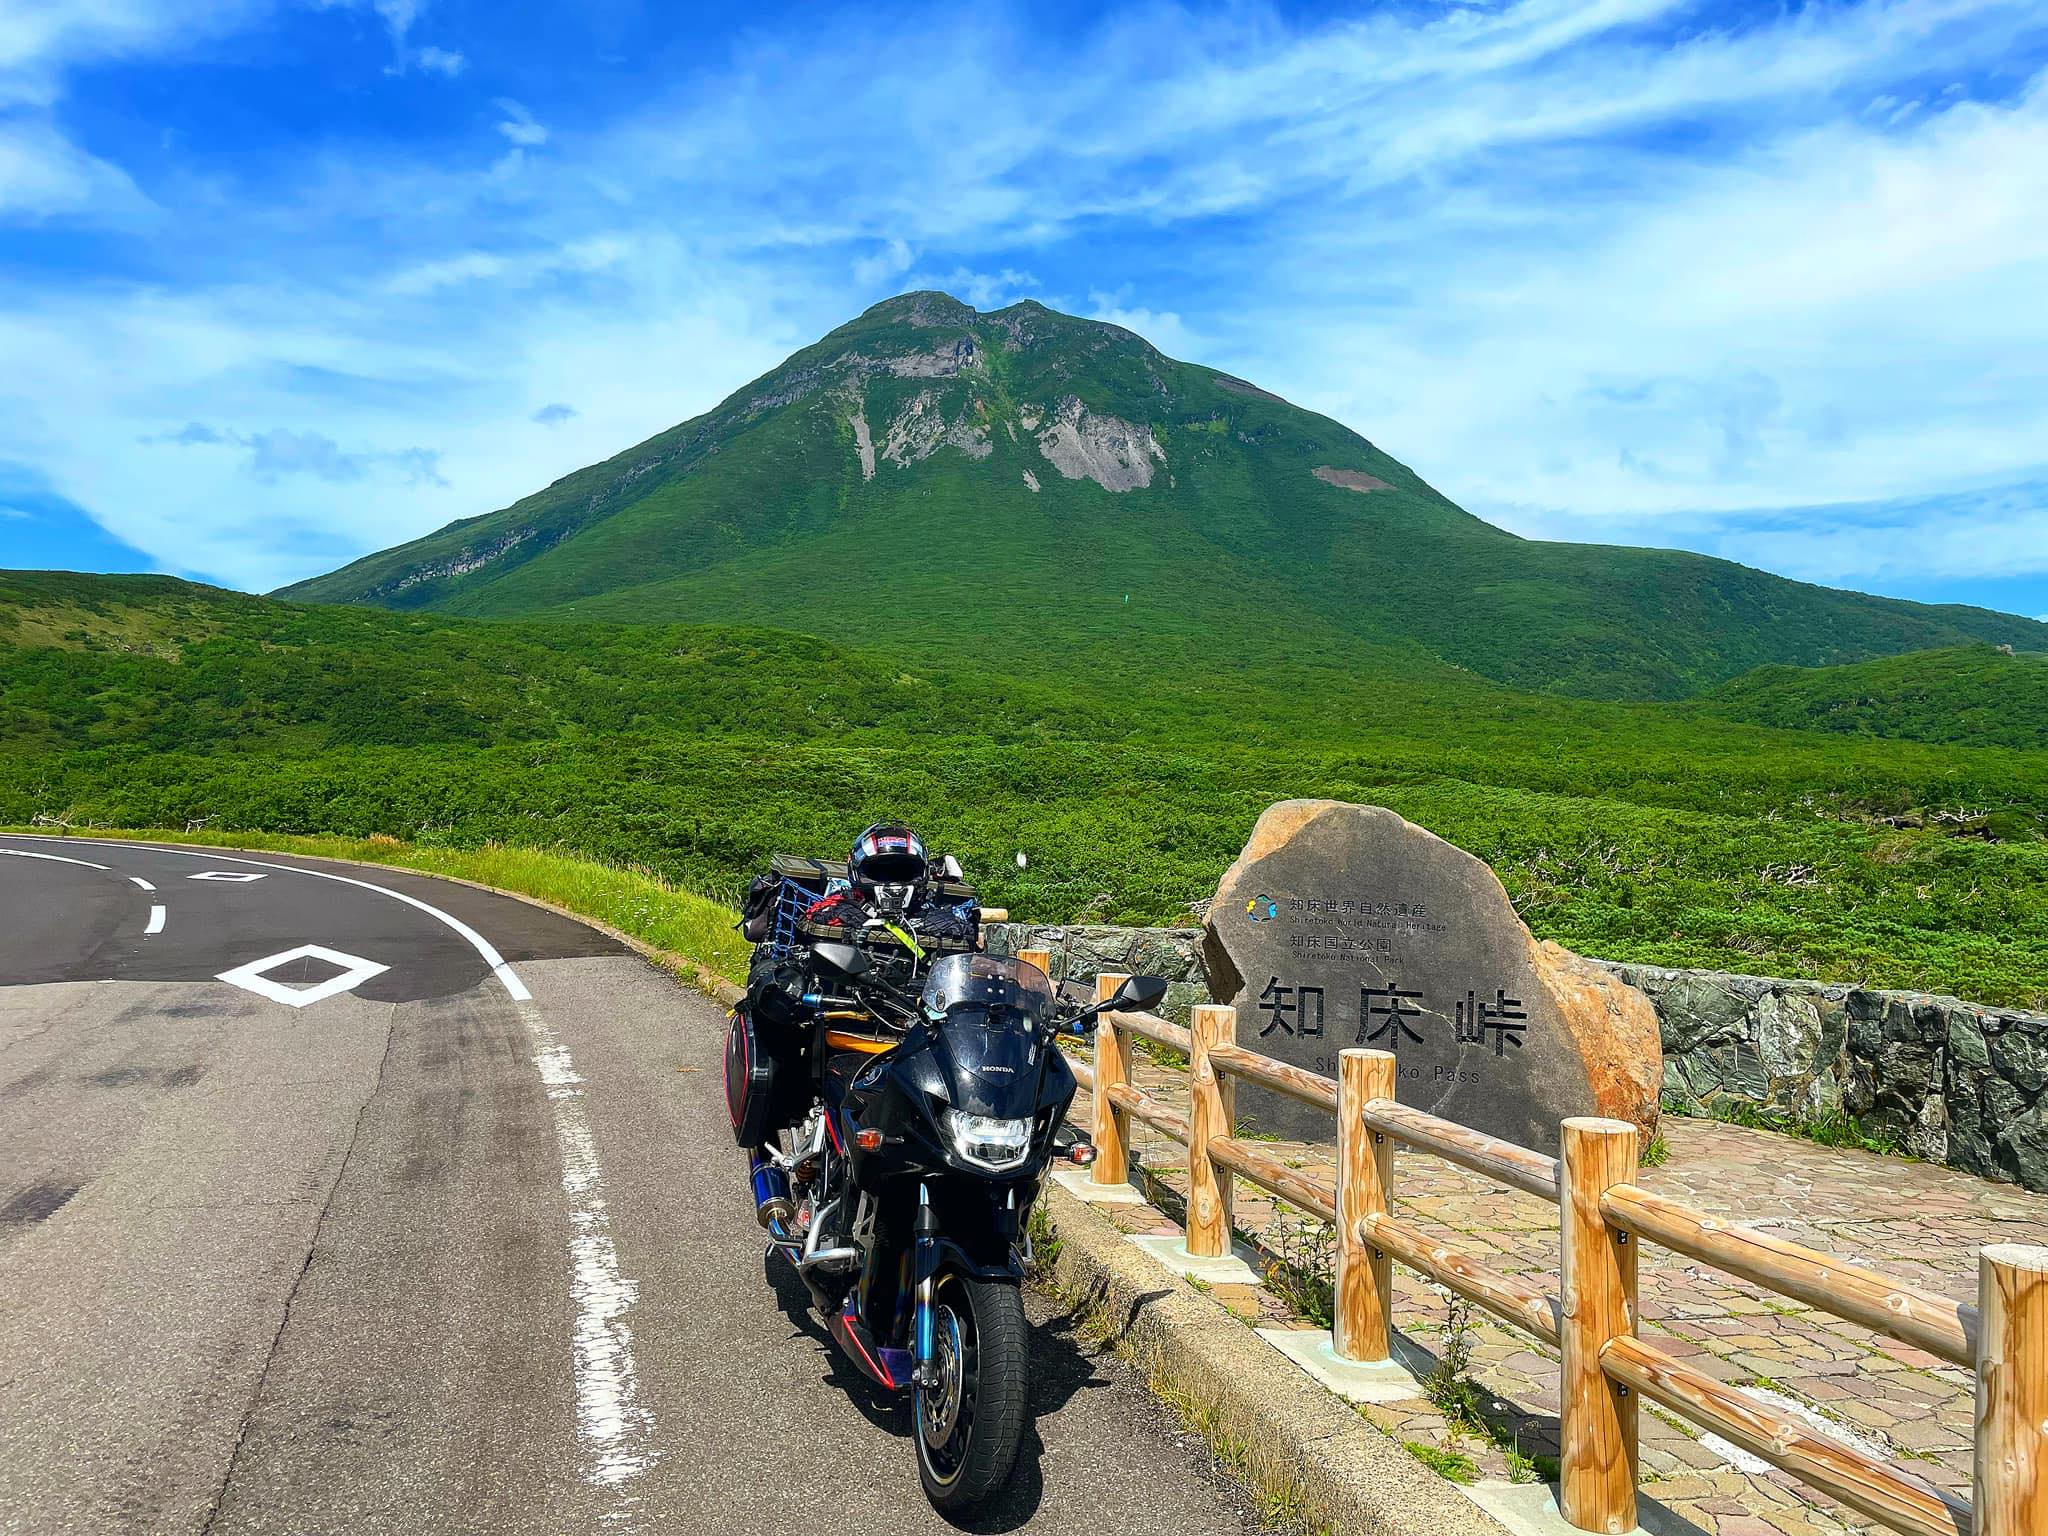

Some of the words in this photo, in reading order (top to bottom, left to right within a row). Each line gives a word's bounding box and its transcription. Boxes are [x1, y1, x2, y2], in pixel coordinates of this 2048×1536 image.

[1289, 898, 1427, 918] 知床世界自然遺産
[1290, 916, 1333, 925] Shiretoko
[1337, 918, 1363, 927] World
[1406, 921, 1447, 932] Heritage
[1289, 934, 1392, 952] 知床国立公園
[1292, 951, 1336, 961] Shiretoko
[1384, 955, 1405, 964] Park
[1259, 976, 1527, 1057] 知床峠
[982, 1065, 1015, 1074] HONDA
[1434, 1065, 1481, 1084] Pass
